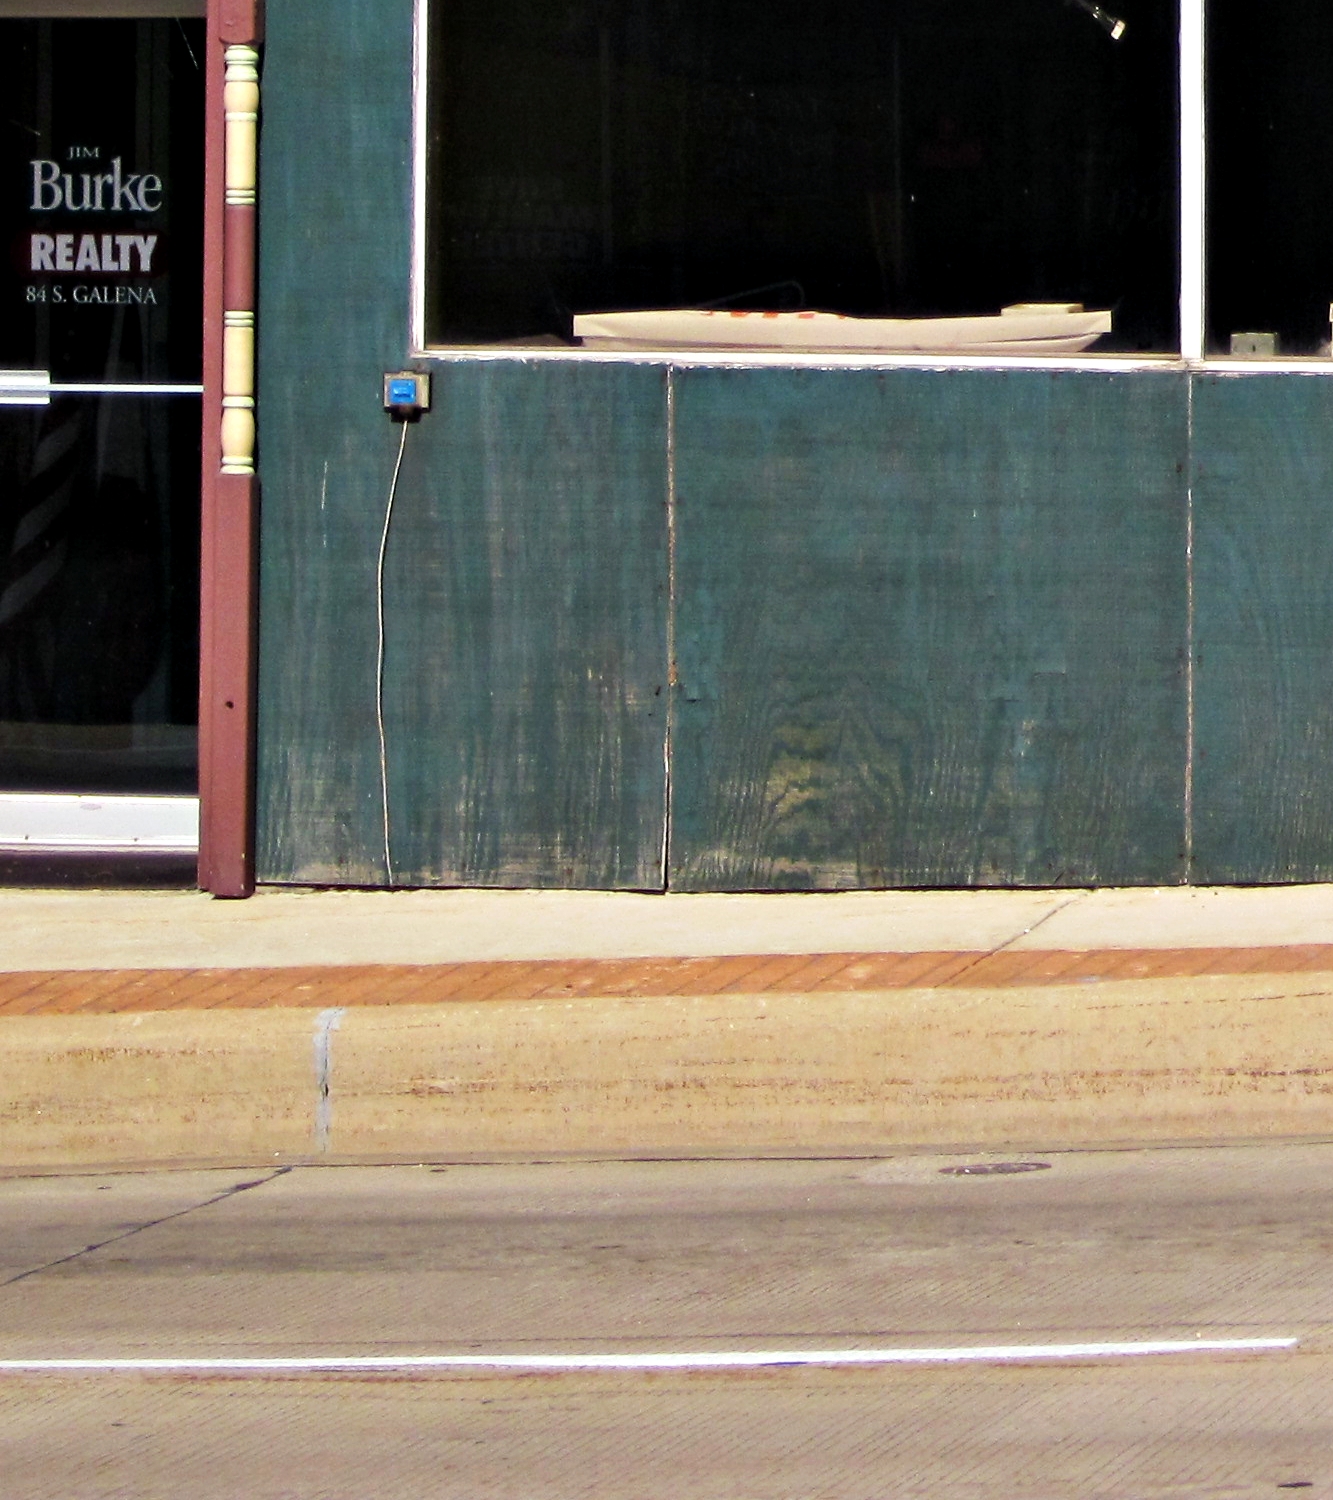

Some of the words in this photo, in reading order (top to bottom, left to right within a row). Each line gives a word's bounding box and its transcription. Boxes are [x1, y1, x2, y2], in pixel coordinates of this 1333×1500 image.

[68, 146, 100, 159] JIM
[29, 156, 163, 212] Burke
[30, 233, 158, 272] REALTY
[26, 286, 47, 303] 84
[52, 286, 67, 303] S.
[73, 286, 157, 304] GALENA
